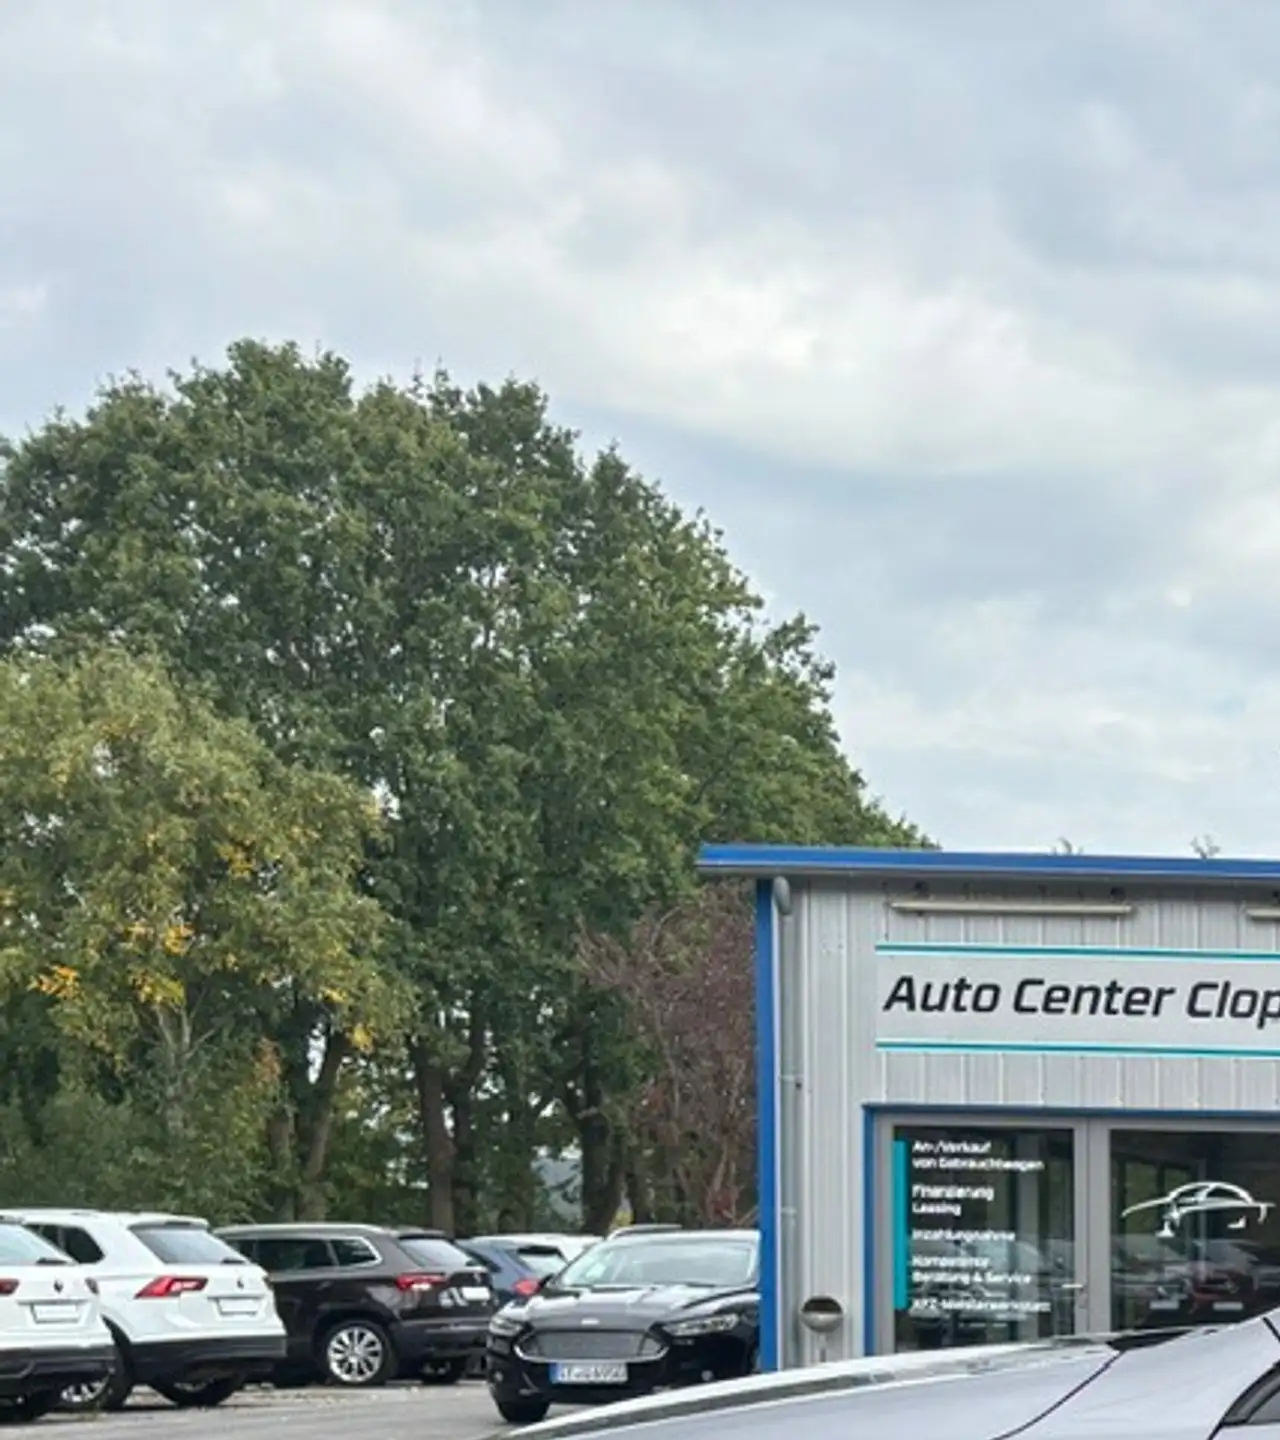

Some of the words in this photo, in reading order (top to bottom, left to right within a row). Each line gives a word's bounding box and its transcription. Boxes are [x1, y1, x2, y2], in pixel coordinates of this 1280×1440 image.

[882, 975, 1001, 1013] Auto
[1013, 978, 1176, 1017] Center
[912, 1203, 962, 1216] Leasing
